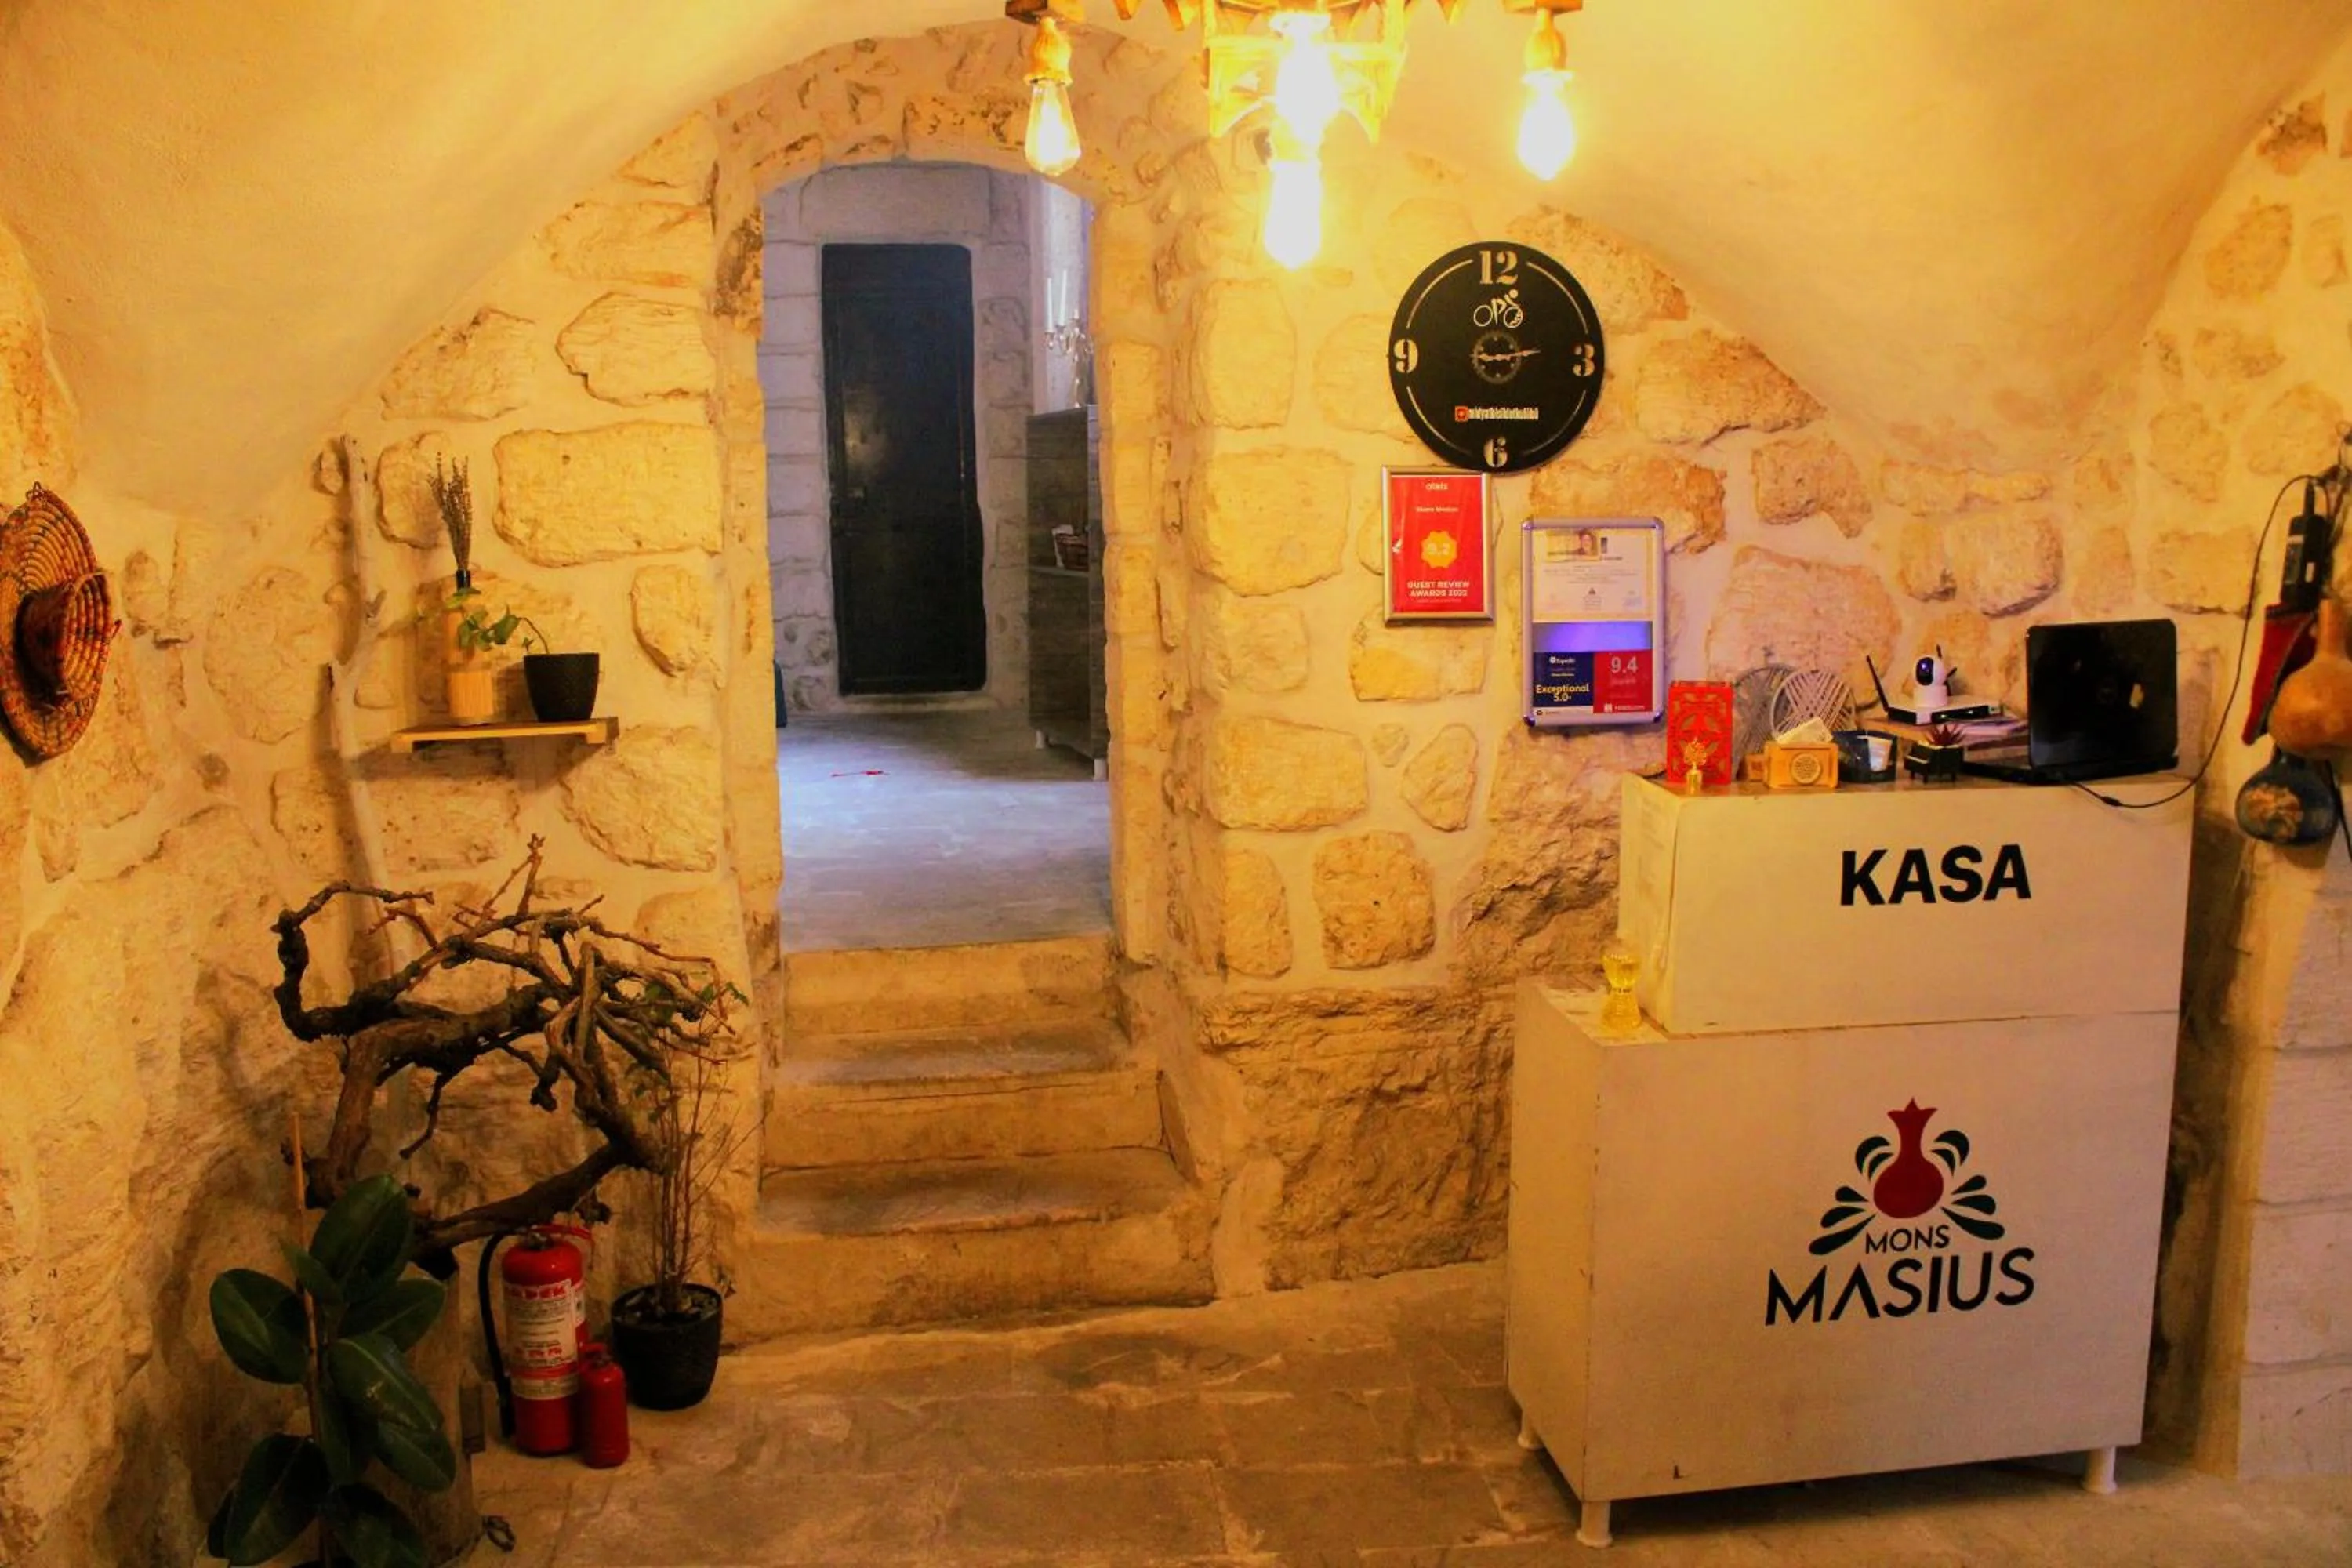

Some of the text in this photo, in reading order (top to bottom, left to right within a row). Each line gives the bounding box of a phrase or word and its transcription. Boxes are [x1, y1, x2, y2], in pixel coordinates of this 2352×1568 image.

[1479, 250, 1518, 285] 12
[1394, 338, 1417, 374] 9
[1572, 343, 1595, 377] 3
[1483, 437, 1508, 468] 6
[1437, 580, 1470, 589] REVIEW
[1611, 655, 1639, 673] 9.4
[1535, 683, 1590, 695] Exceptional
[1840, 843, 2032, 906] KASA
[1865, 1225, 1951, 1254] MONS
[1765, 1247, 2035, 1326] MASIUS
